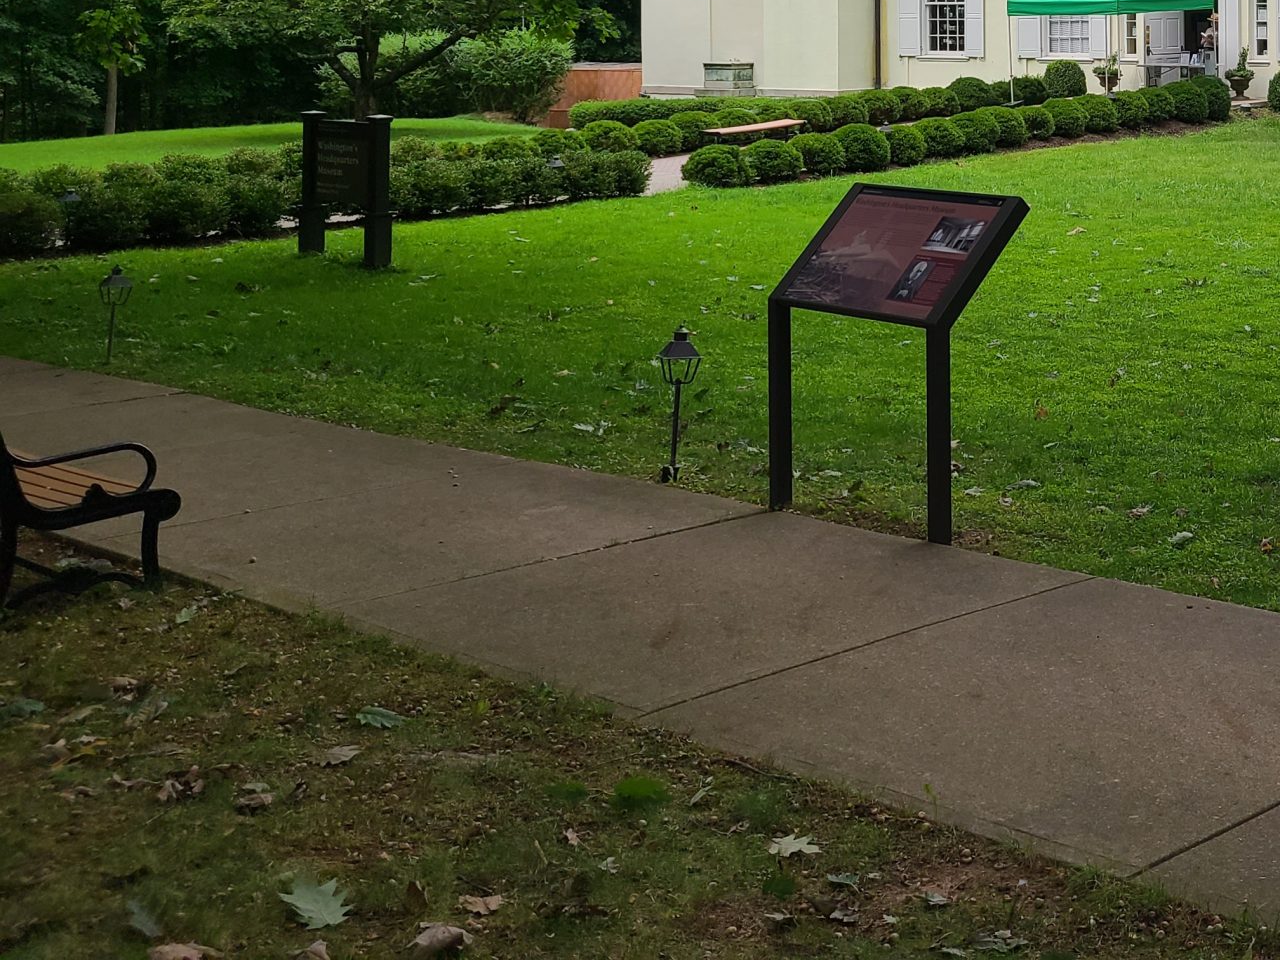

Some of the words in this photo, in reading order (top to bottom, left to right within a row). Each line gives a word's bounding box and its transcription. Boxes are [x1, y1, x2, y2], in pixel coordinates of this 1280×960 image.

[317, 140, 358, 153] Washington's
[317, 152, 359, 165] Headquarters
[318, 166, 343, 176] Museum
